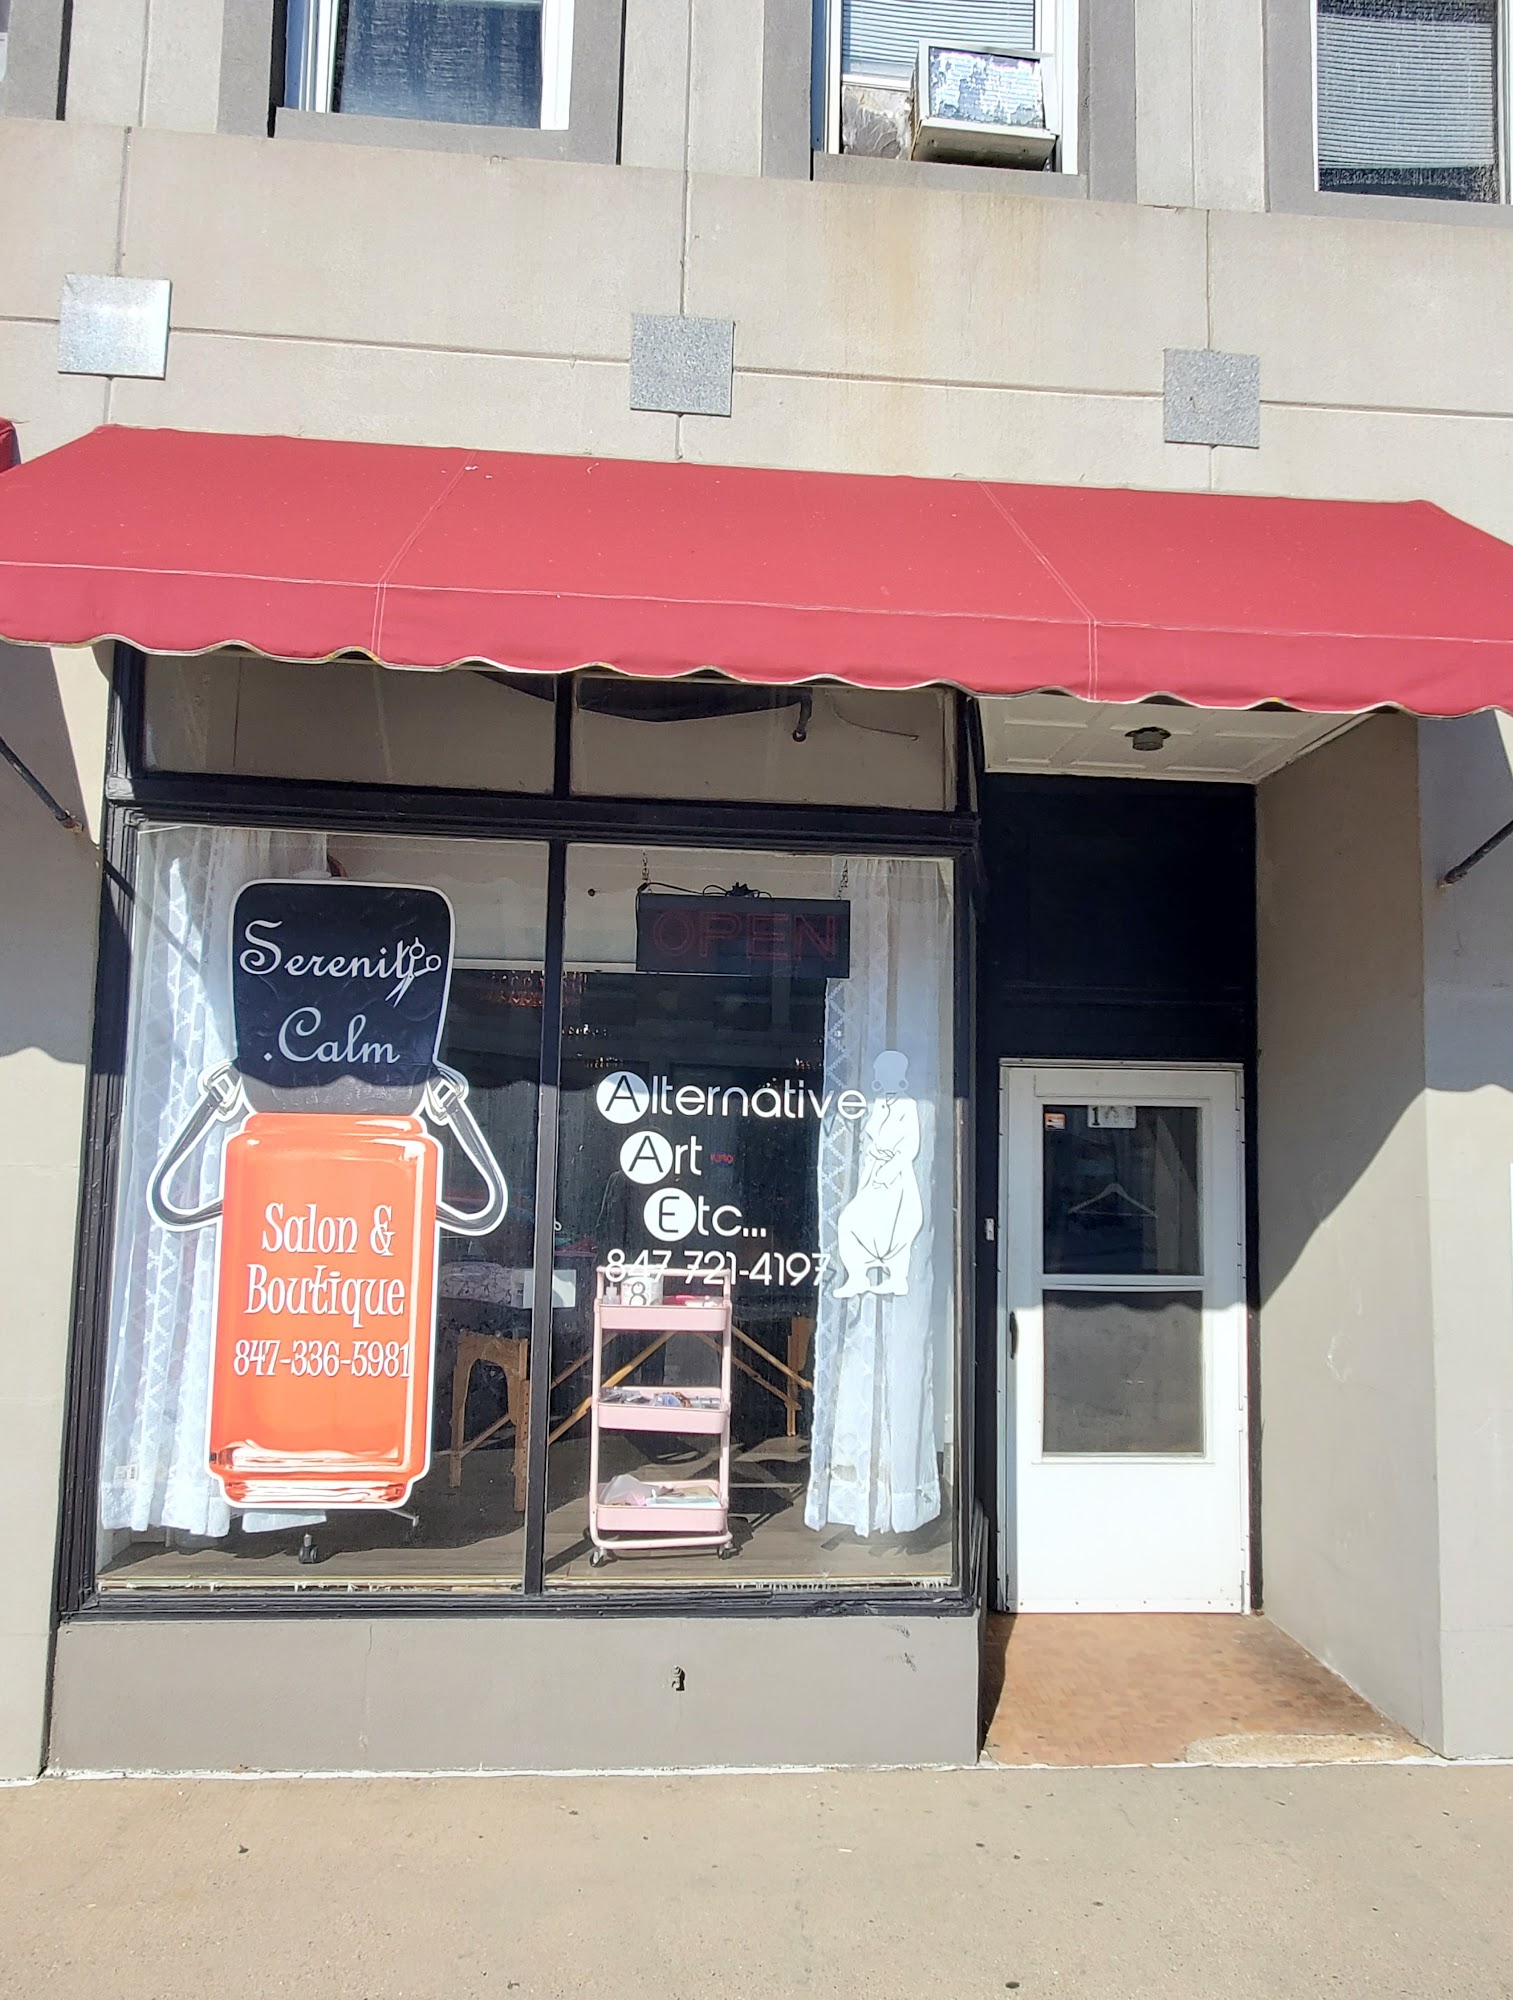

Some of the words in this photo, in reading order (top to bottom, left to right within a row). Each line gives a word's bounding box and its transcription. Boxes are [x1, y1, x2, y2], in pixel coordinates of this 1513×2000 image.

[653, 910, 837, 961] OPEN
[596, 1071, 867, 1124] Alternative
[619, 1130, 703, 1185] Art
[261, 1202, 358, 1254] Salon
[369, 1204, 396, 1257] &
[643, 1187, 767, 1242] Etc...
[605, 1248, 672, 1283] 847
[684, 1250, 831, 1287] 721-4197
[243, 1263, 406, 1329] Boutique
[233, 1339, 411, 1378] 847-336-5981
